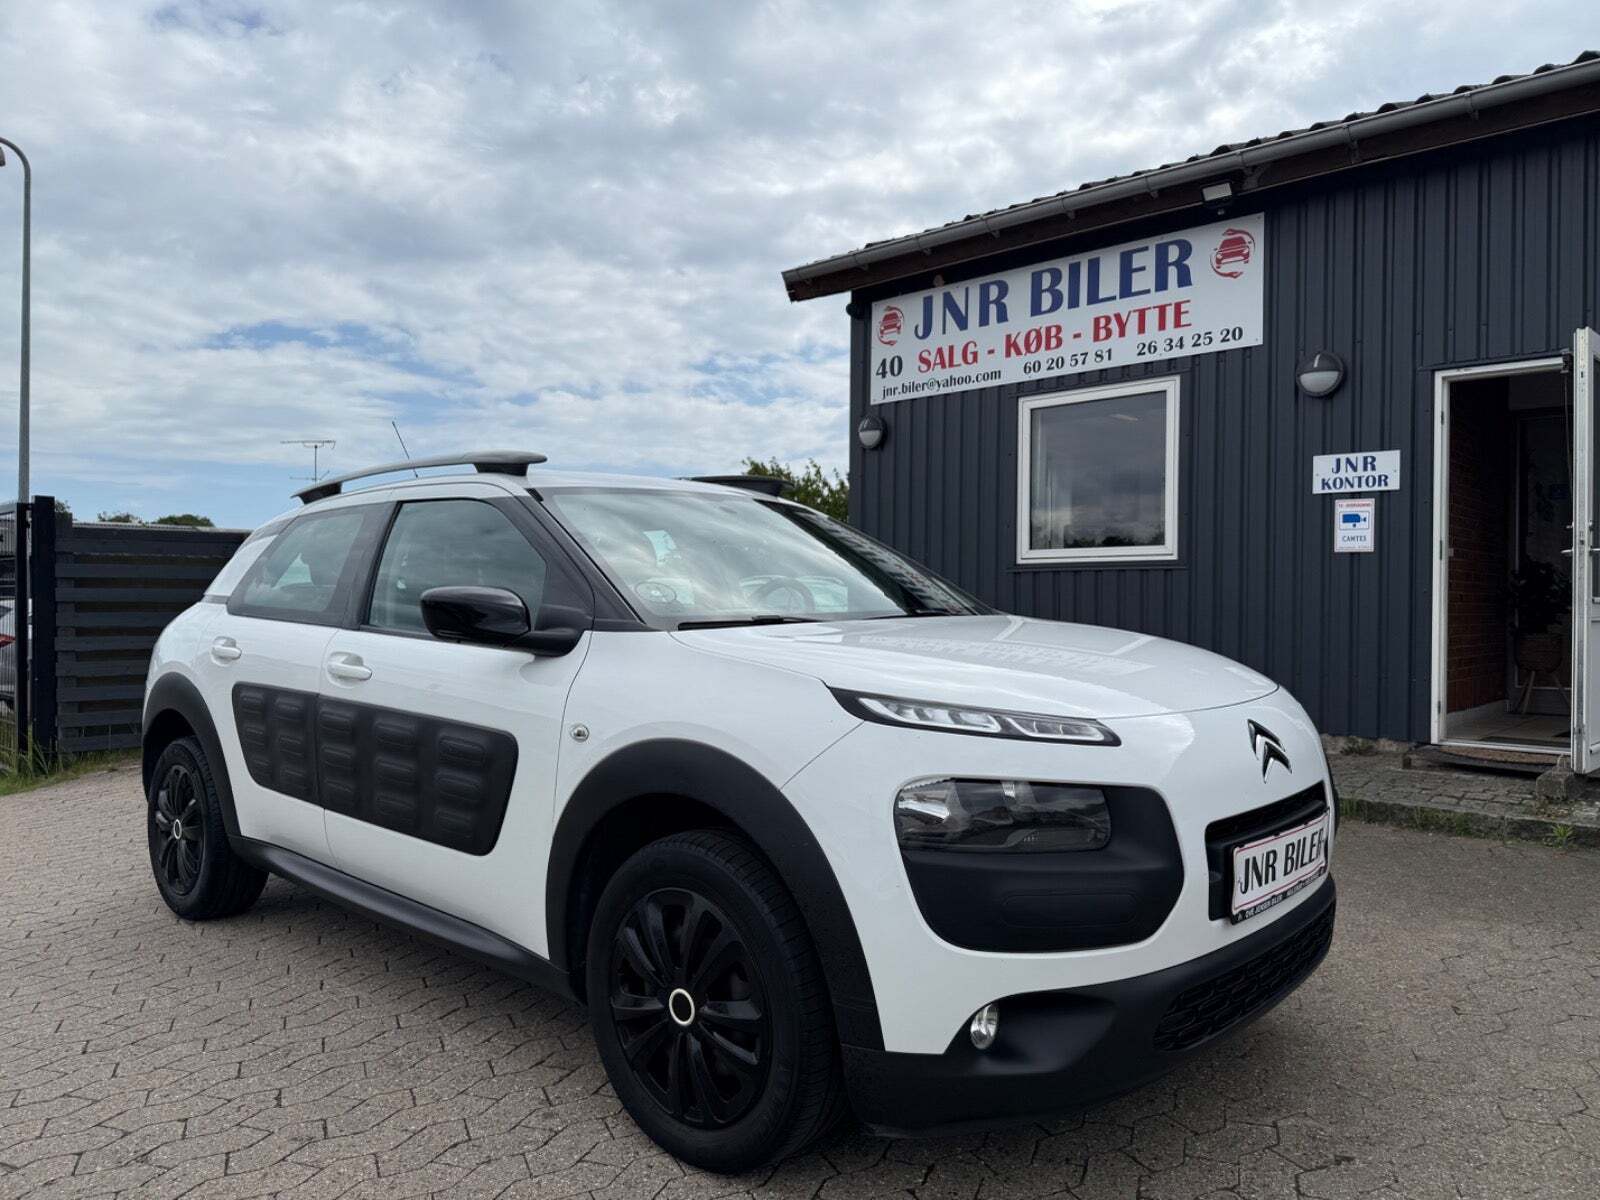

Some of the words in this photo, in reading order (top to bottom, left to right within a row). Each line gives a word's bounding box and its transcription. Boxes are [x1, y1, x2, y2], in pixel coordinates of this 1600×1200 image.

[914, 279, 1009, 340] JNR
[1030, 238, 1193, 317] BILER
[918, 340, 978, 373] SALG
[1004, 323, 1063, 358] KØB
[1093, 299, 1192, 343] BYTTE
[1136, 341, 1158, 356] 26
[1163, 337, 1185, 352] 34
[1191, 331, 1213, 347] 25
[1220, 326, 1244, 343] 20
[876, 355, 903, 379] 40
[1023, 360, 1042, 375] 60
[1046, 356, 1065, 371] 20
[1069, 352, 1089, 367] 57
[1094, 348, 1113, 363] 81
[882, 369, 1001, 399] jnr.biler@yahoo.com
[1332, 455, 1377, 474] JNR
[1321, 474, 1389, 490] KONTOR
[1238, 848, 1278, 895] JNR
[1283, 828, 1325, 876] BILER
